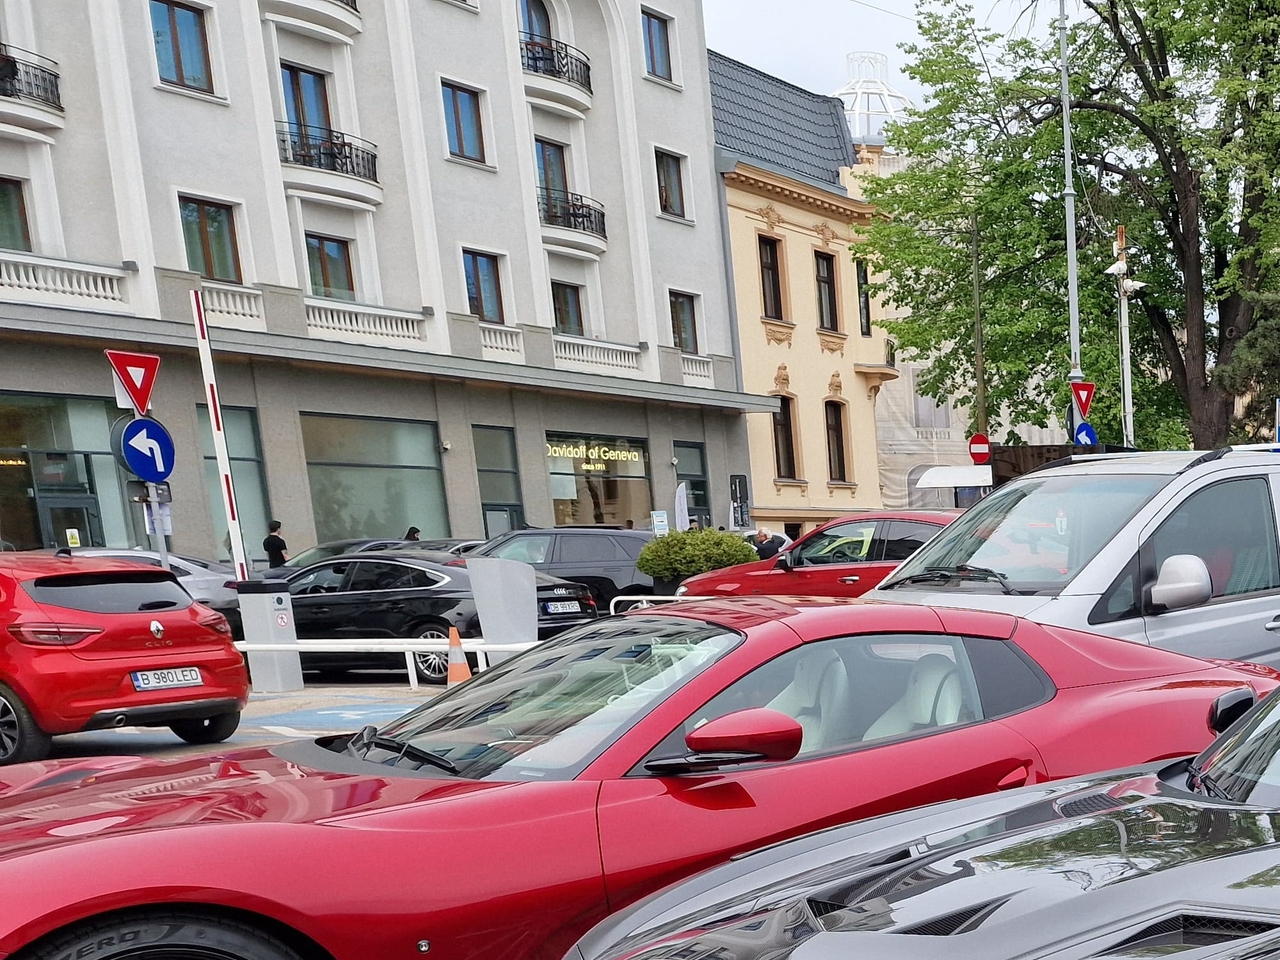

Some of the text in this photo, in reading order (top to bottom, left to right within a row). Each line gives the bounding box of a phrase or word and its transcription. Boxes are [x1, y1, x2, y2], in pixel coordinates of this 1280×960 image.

[588, 446, 599, 460] of
[600, 447, 639, 461] Geneva
[140, 673, 150, 685] B
